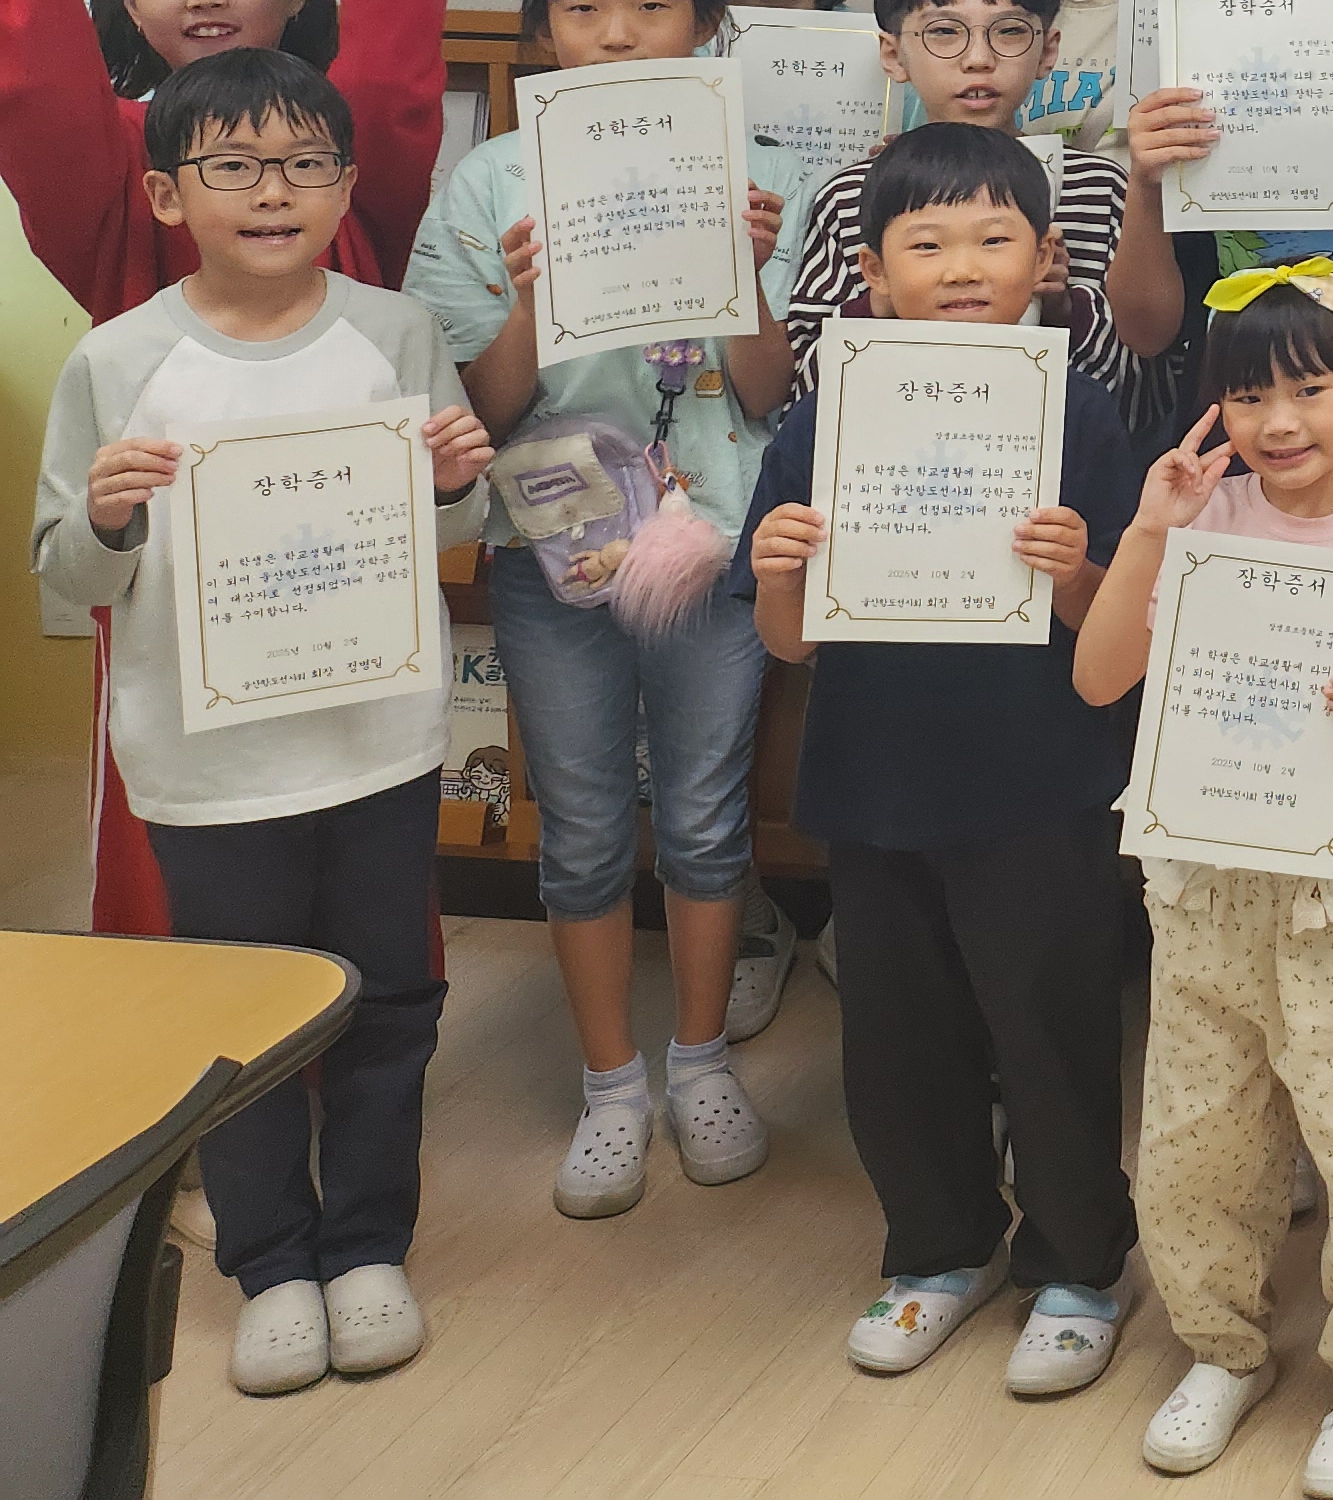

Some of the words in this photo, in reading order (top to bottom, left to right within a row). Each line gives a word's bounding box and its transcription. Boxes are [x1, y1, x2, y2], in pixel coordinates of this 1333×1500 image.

[895, 379, 991, 404] 장학증서
[252, 465, 352, 497] 장학증서
[1235, 566, 1327, 598] 장학증서
